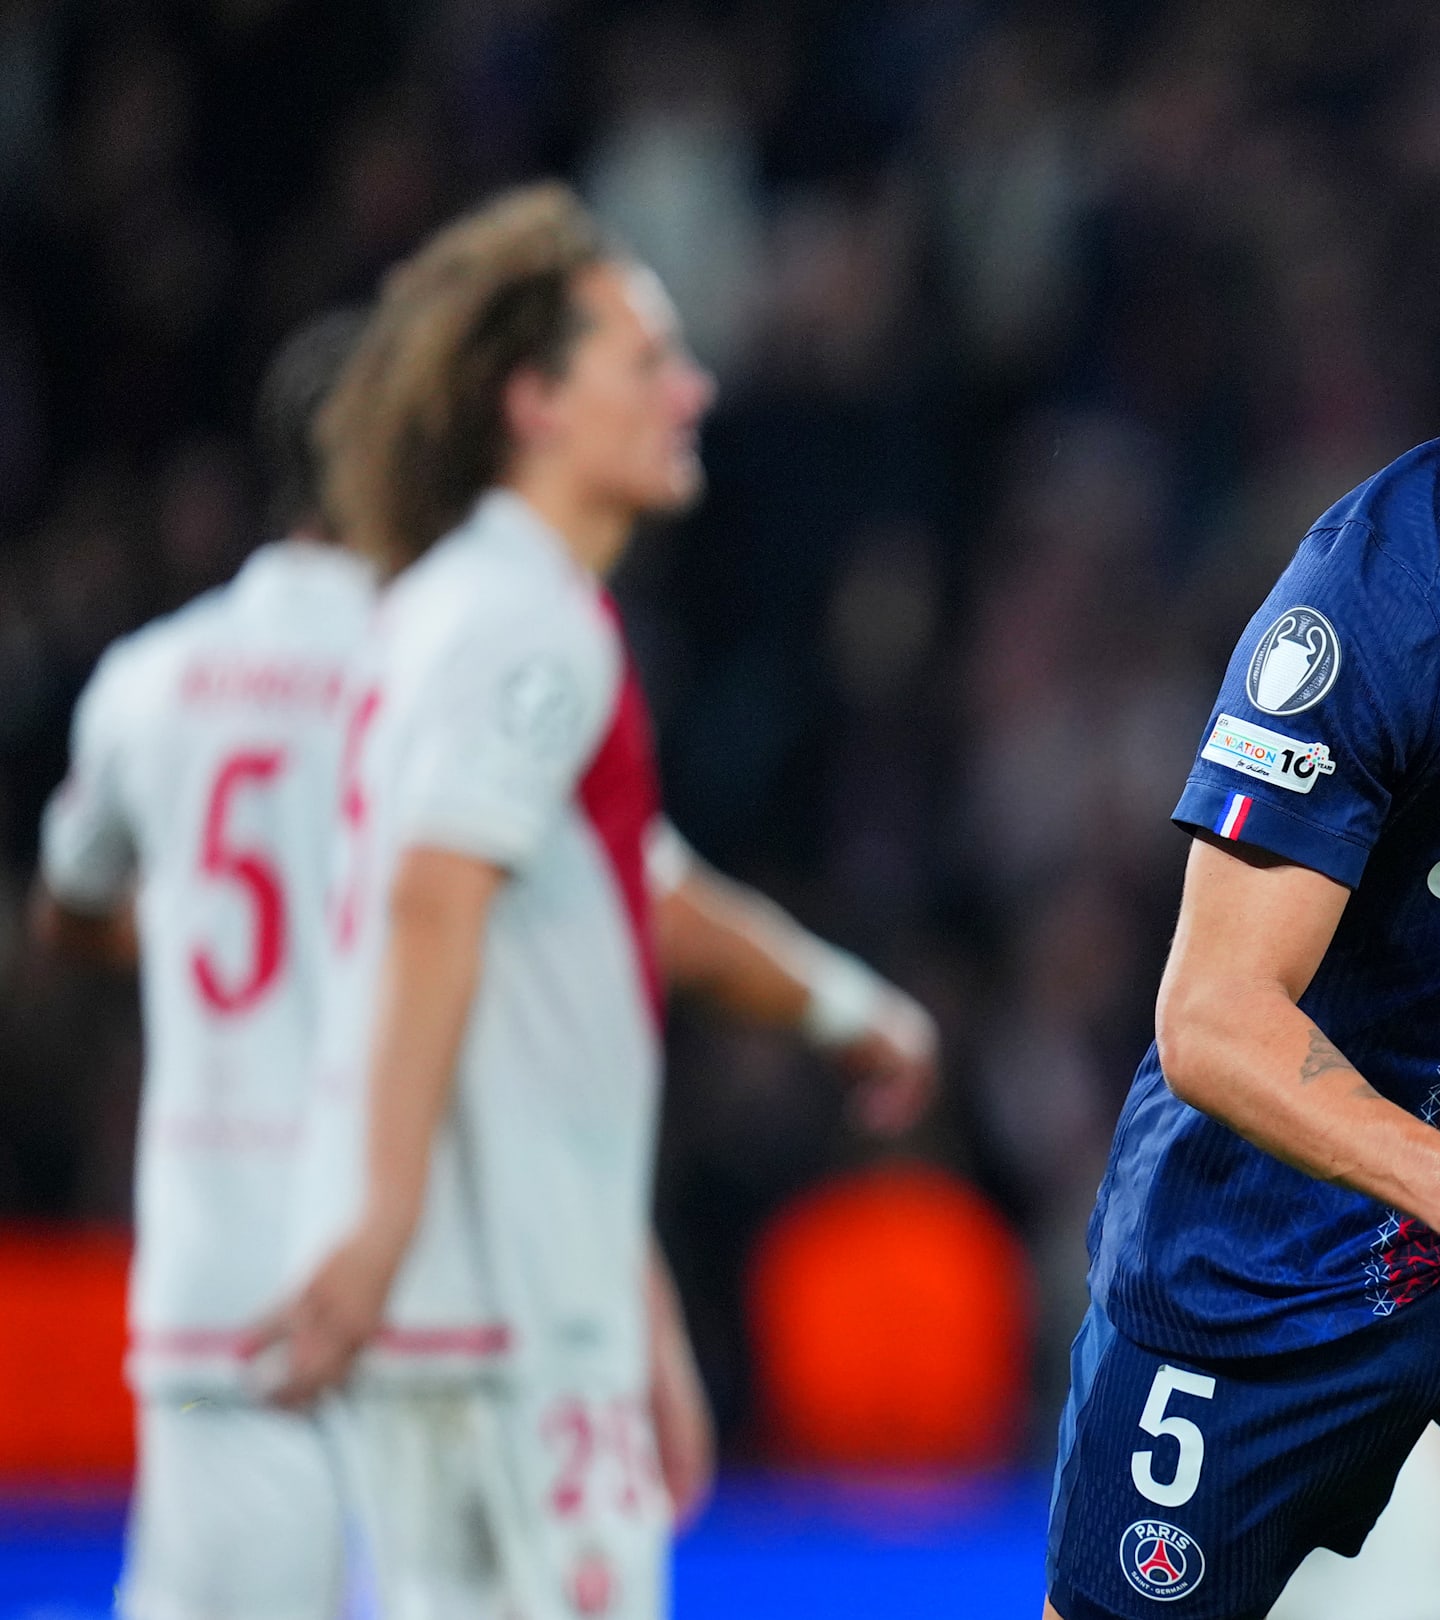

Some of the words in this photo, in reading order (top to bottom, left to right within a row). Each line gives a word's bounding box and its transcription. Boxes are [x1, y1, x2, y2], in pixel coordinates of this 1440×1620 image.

[1281, 749, 1316, 779] 10
[188, 744, 290, 1022] 5
[1130, 1364, 1216, 1507] 5
[1134, 1524, 1190, 1550] PARIS
